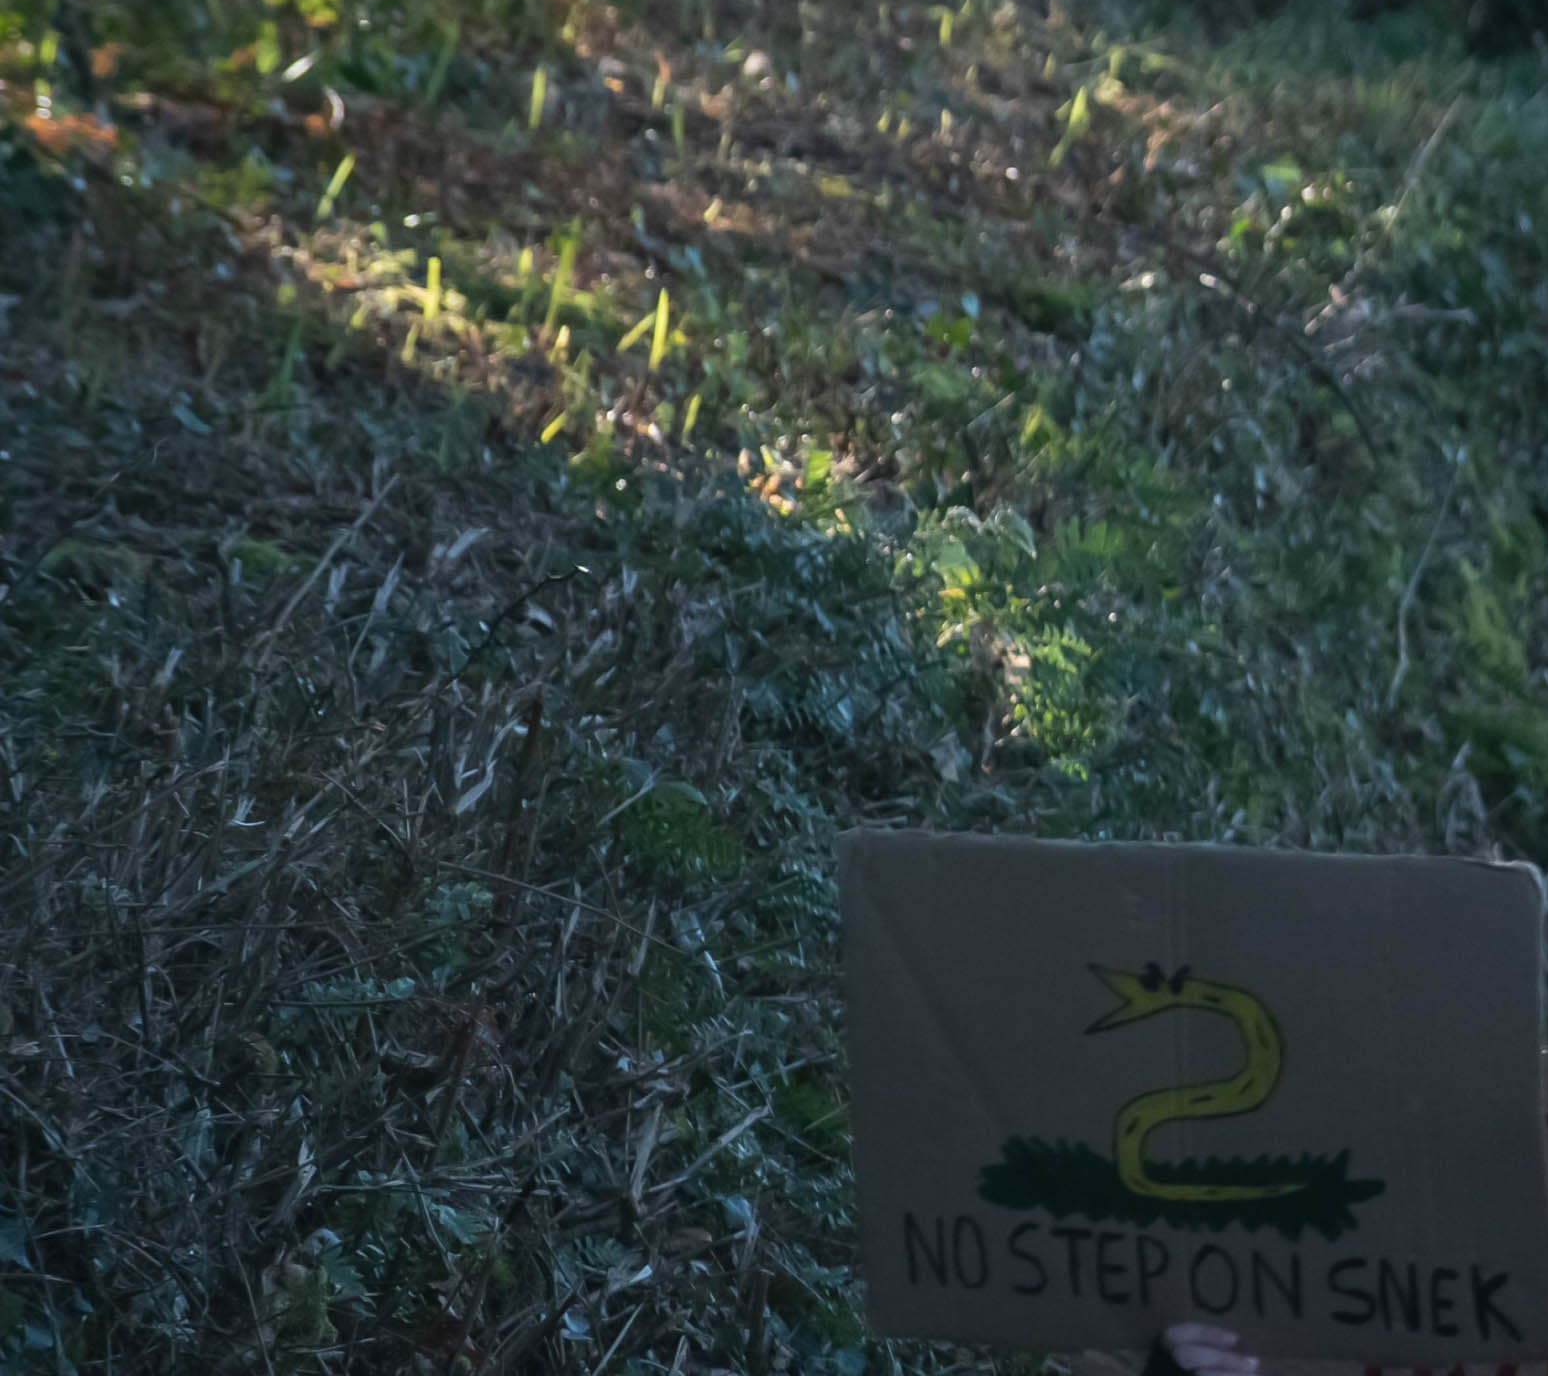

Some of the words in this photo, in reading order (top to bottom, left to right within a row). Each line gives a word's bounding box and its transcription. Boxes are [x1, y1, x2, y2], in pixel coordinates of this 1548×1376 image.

[901, 1212, 990, 1289] NO
[1007, 1221, 1171, 1307] STEP
[1189, 1242, 1302, 1319] ON
[1325, 1256, 1525, 1344] SNEK
